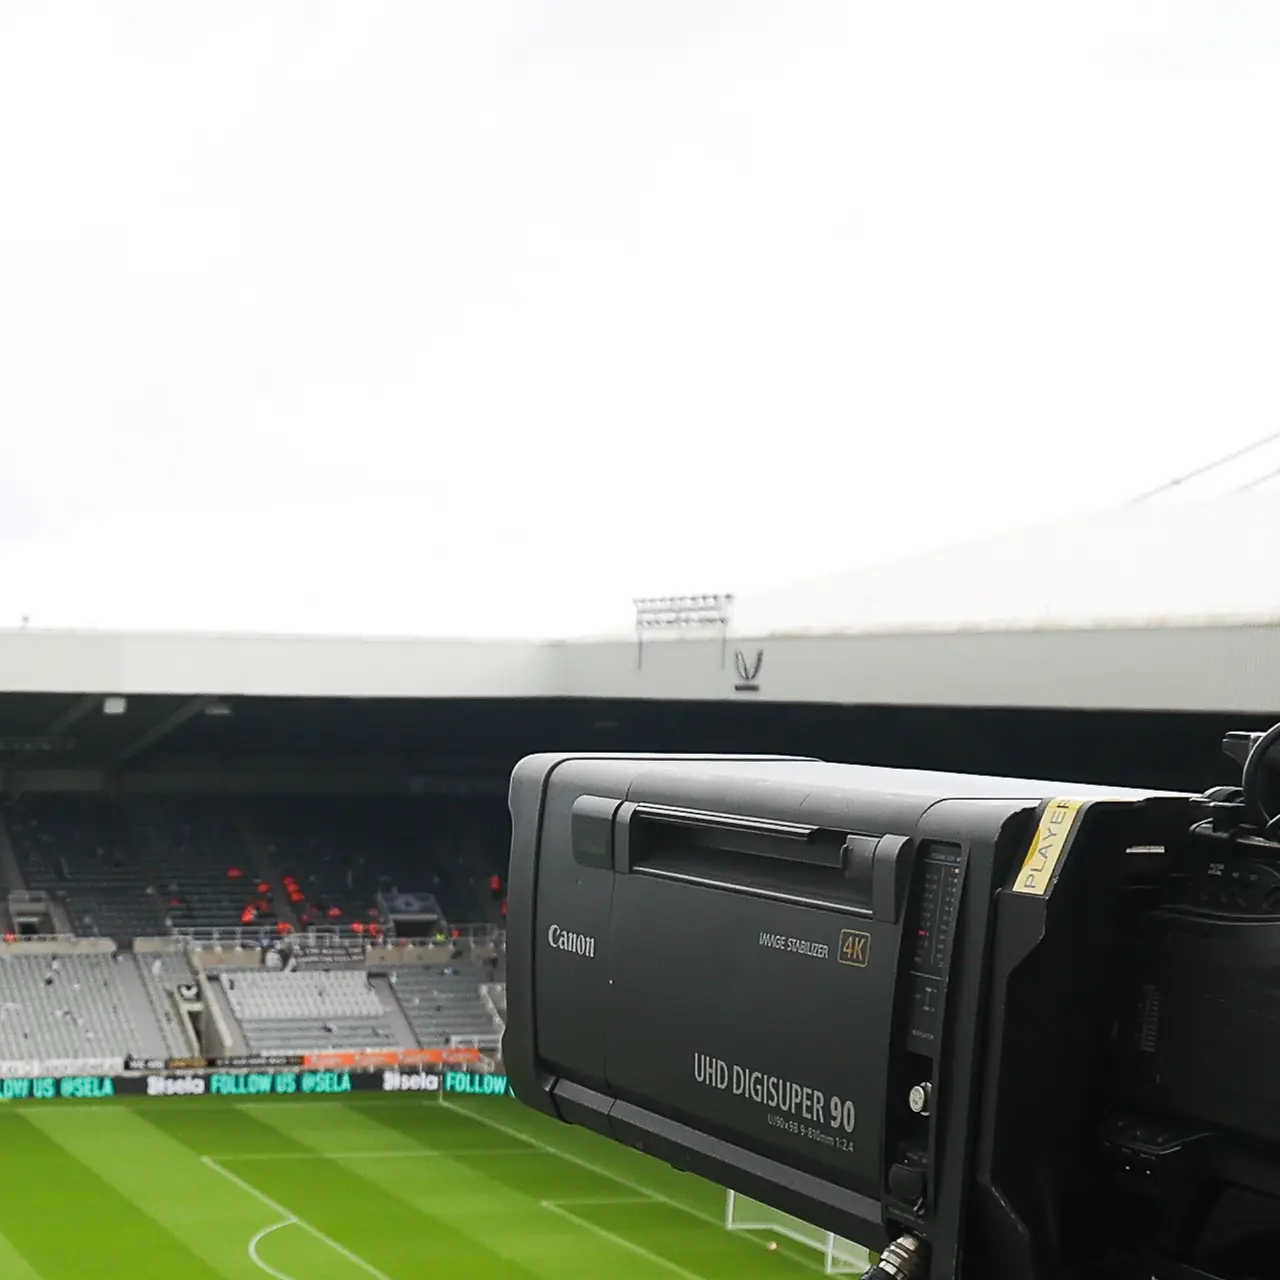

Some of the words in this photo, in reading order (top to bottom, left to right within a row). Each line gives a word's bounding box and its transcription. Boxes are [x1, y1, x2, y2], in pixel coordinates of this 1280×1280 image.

[547, 924, 596, 958] Canon
[759, 932, 785, 950] IMAGE
[787, 936, 829, 959] STABILIZER
[842, 938, 866, 961] 4K
[32, 1077, 56, 1099] US
[210, 1073, 273, 1094] FOLLOW
[274, 1073, 296, 1093] US
[444, 1071, 507, 1094] FOLLOW
[694, 1052, 729, 1090] UHD
[732, 1064, 825, 1124] DIGISUPER
[830, 1096, 856, 1134] 90
